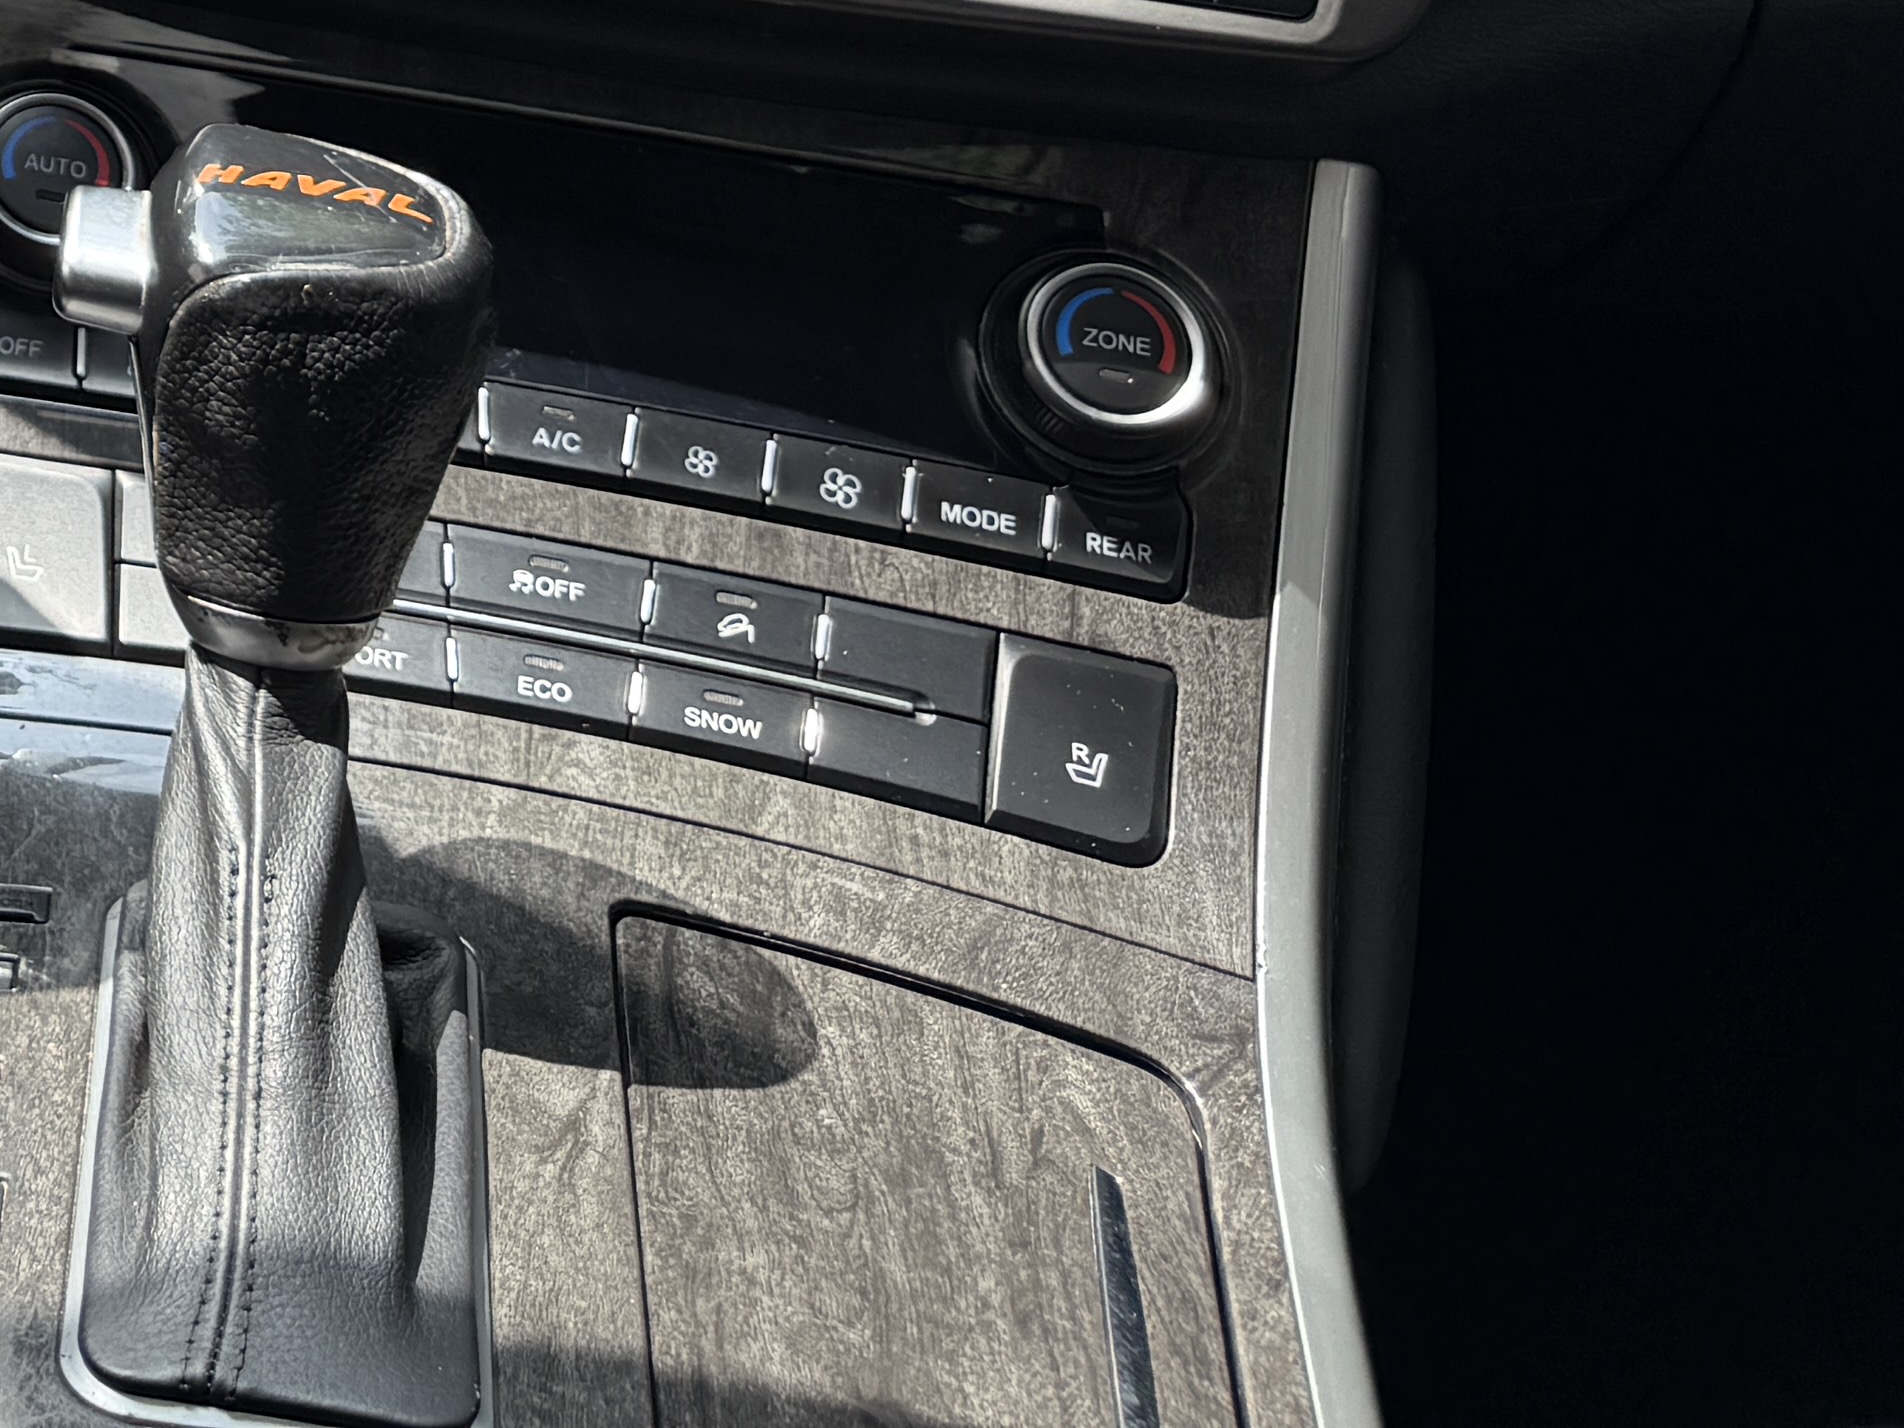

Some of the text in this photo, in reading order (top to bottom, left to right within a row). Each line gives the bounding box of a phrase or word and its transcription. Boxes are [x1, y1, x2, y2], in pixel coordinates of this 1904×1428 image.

[24, 152, 88, 178] AUTO
[198, 163, 434, 224] HAVAL
[1082, 327, 1152, 356] ZONE
[532, 429, 582, 454] A/C
[940, 501, 1017, 537] MODE
[1085, 532, 1153, 564] REAR
[535, 580, 586, 602] OFF
[356, 646, 409, 671] ORT
[517, 675, 572, 704] ECO
[683, 707, 763, 740] SNOW
